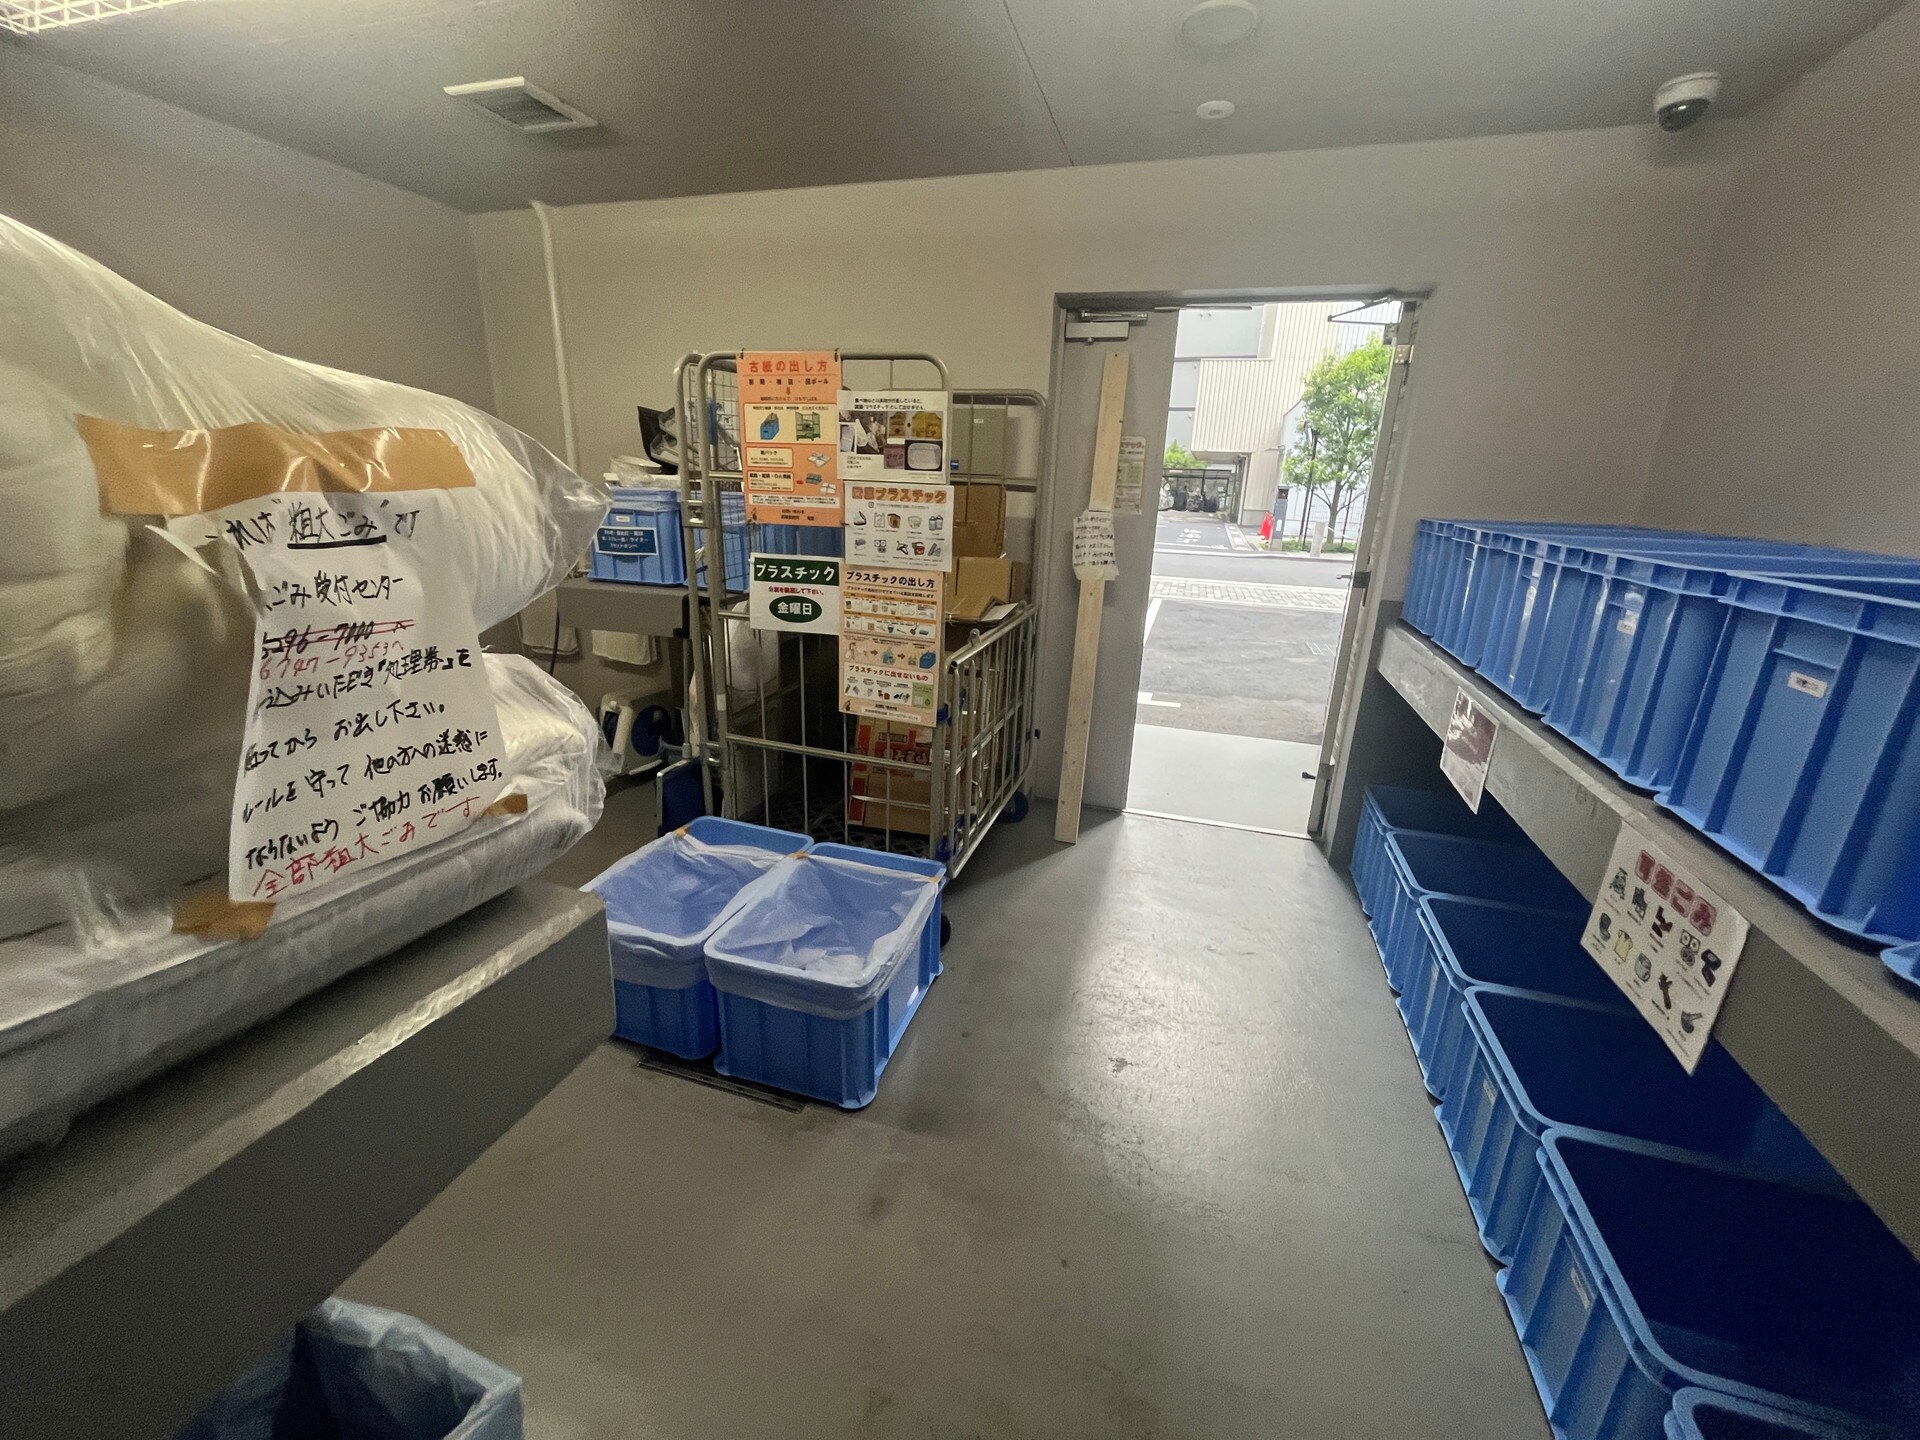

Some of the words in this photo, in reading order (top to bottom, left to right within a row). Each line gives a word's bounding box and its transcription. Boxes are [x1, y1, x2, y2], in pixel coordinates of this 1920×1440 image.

[748, 360, 828, 373] 古紙の出し方
[755, 563, 835, 582] プラスチック
[846, 571, 935, 589] プラスチックの出し方
[265, 569, 404, 612] ごみ受付センター
[777, 602, 812, 616] 金曜日
[848, 665, 929, 682] プラスチックに出せないもの
[304, 764, 352, 798] 守って
[352, 790, 412, 827] ご協力
